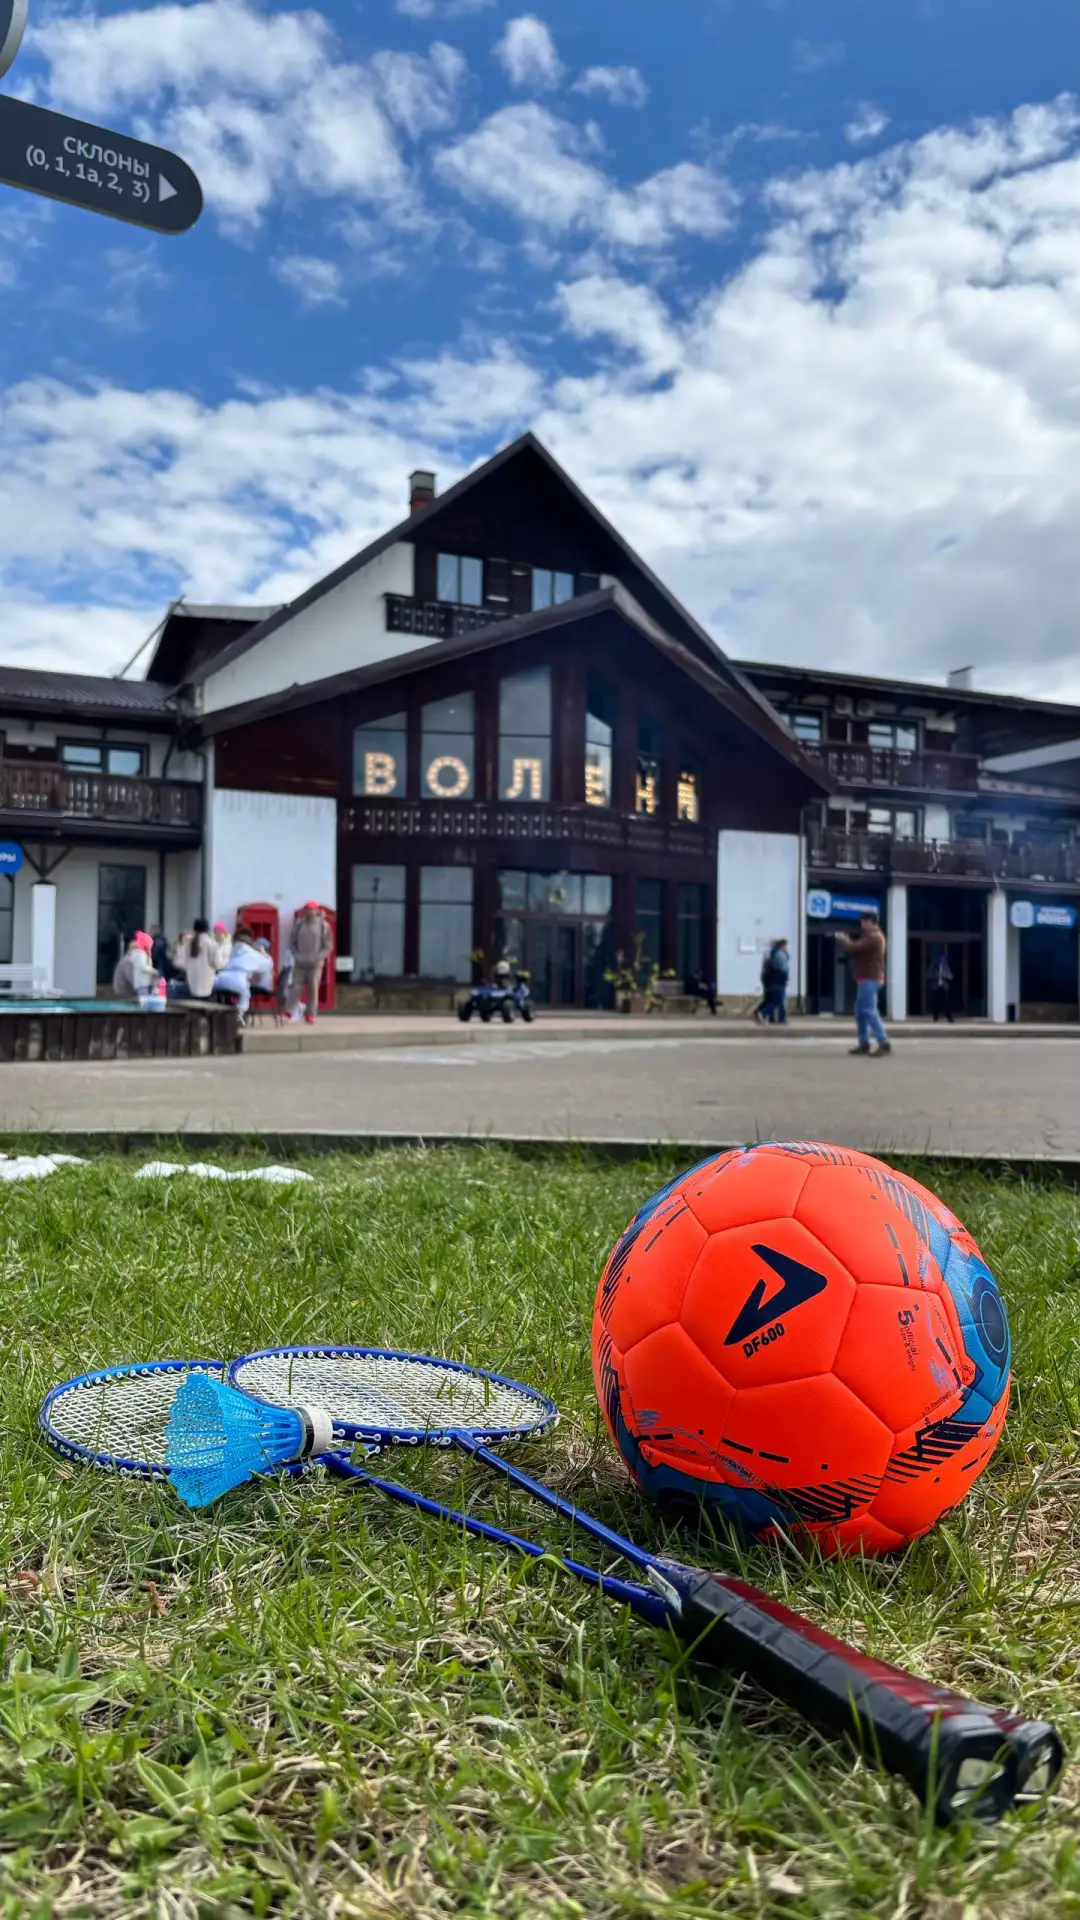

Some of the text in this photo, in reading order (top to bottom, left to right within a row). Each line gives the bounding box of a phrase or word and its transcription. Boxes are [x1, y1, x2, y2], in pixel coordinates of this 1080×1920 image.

[63, 136, 150, 178] СКЛОНЫ
[132, 180, 151, 203] 3)
[898, 1310, 915, 1325] 5
[742, 1322, 785, 1358] DF600
